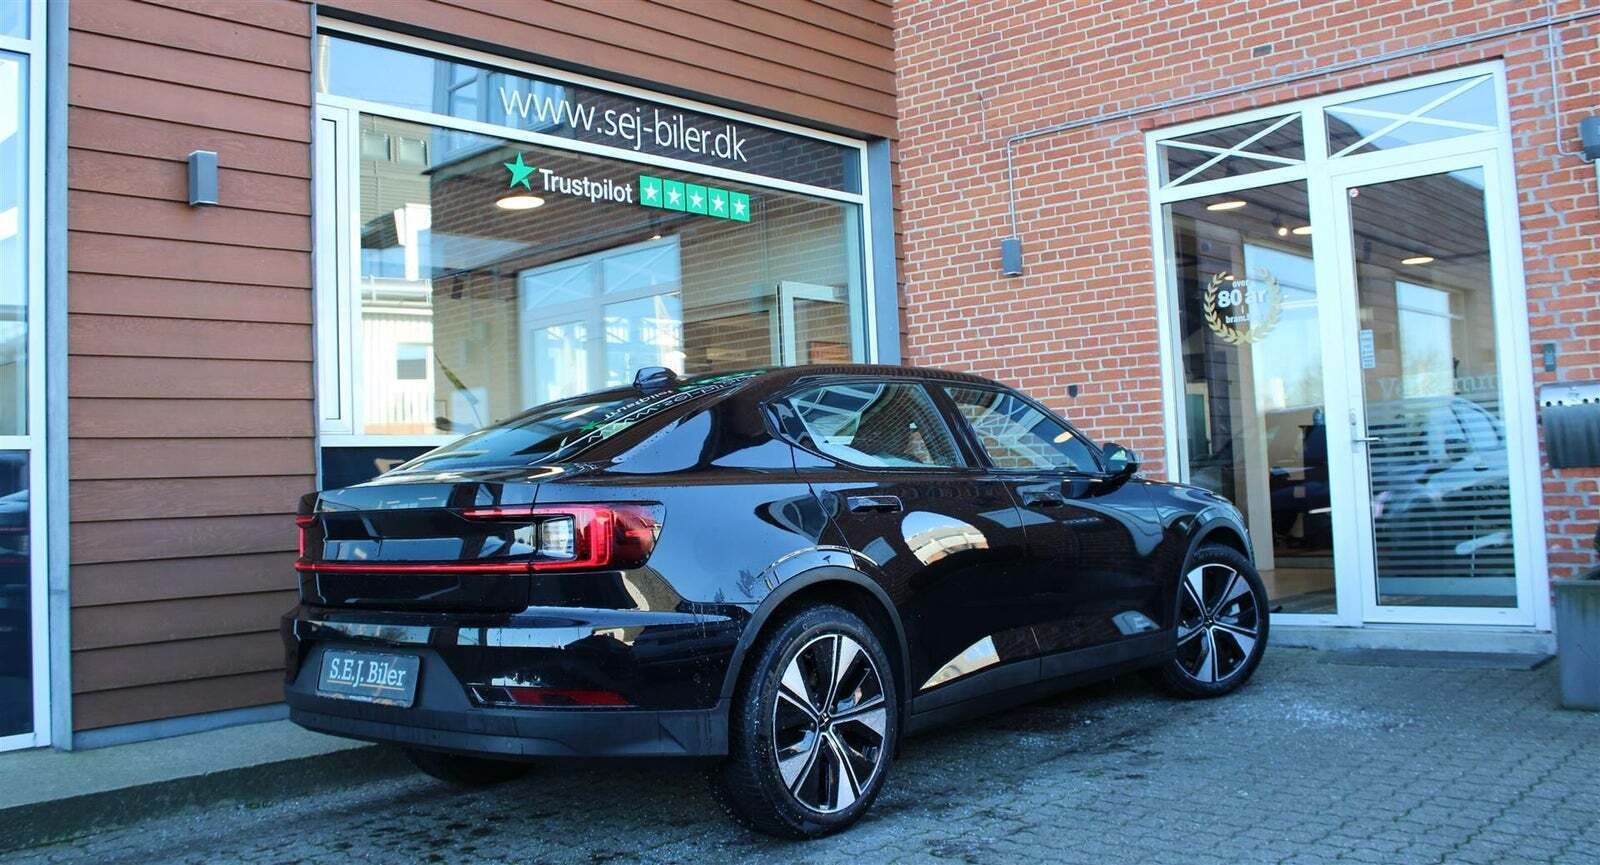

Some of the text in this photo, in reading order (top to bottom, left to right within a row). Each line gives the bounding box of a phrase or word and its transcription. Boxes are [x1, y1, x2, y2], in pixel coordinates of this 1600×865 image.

[500, 87, 748, 162] www.sej-biler.dk
[539, 168, 633, 204] Trustpilot
[1217, 289, 1243, 308] 80
[329, 657, 407, 688] S.E.J. Biler
